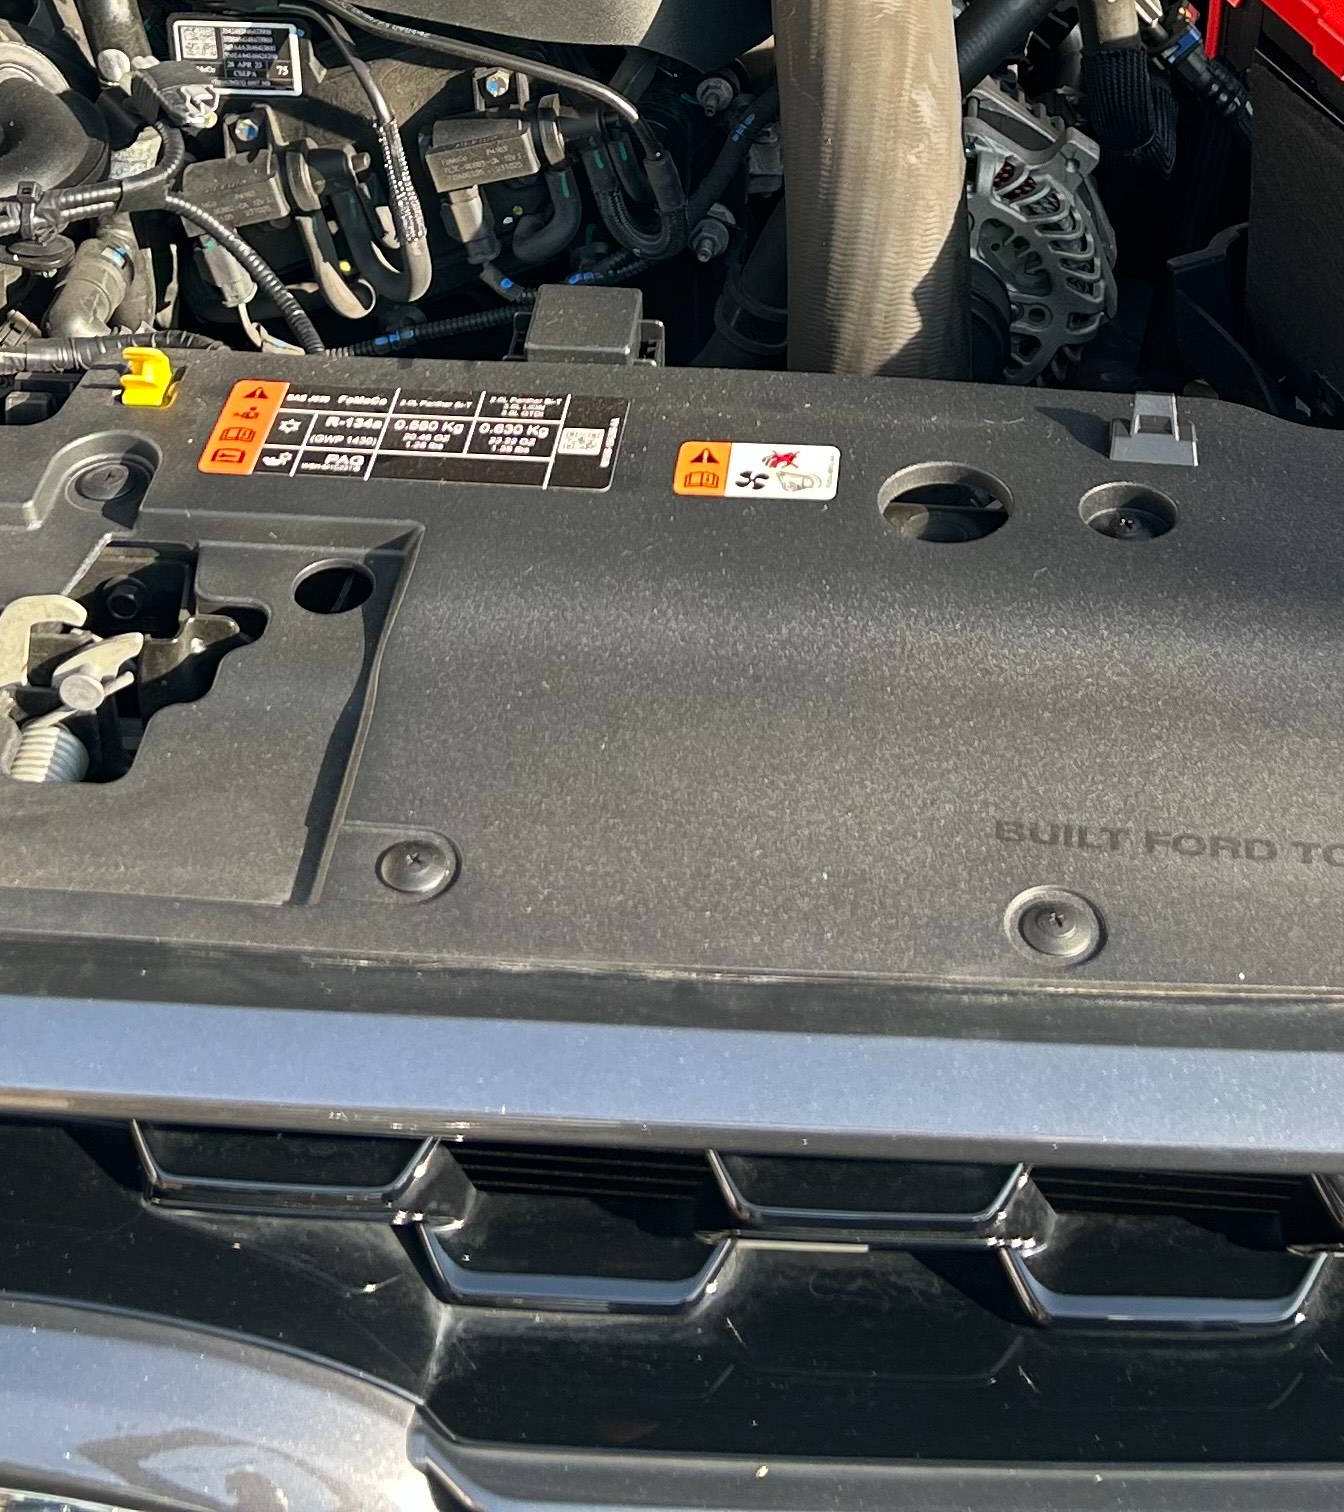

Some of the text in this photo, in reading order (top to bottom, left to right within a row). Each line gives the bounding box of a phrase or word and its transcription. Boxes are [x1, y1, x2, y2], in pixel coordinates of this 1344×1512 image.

[337, 395, 388, 406] FoMoCo
[325, 416, 383, 430] R-134a
[441, 421, 464, 435] Kg
[479, 422, 549, 439] 0.630 Kg
[309, 433, 344, 445] (GWP
[324, 453, 365, 467] PAG
[995, 820, 1128, 851] BUILT
[1143, 829, 1278, 864] FORD
